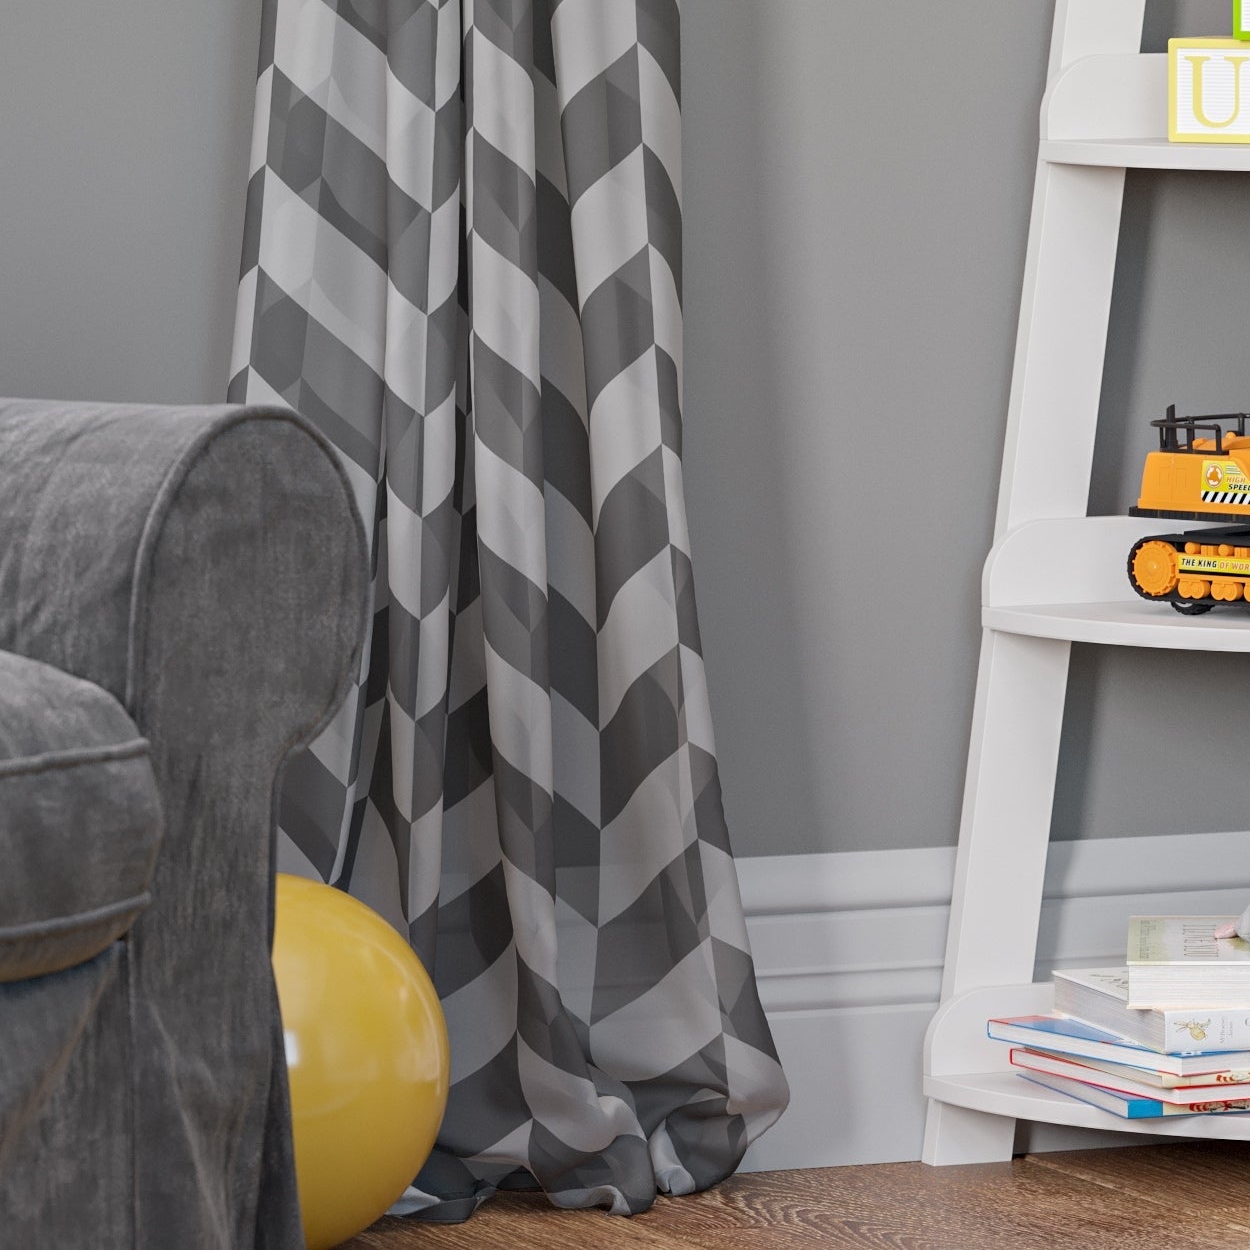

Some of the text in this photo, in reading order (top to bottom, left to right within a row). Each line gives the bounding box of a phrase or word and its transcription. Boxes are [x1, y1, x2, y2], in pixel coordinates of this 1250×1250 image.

[1184, 55, 1250, 129] U
[1226, 476, 1246, 484] HIGH
[1181, 558, 1196, 567] THE
[1198, 559, 1218, 569] KING
[1219, 561, 1230, 569] OF
